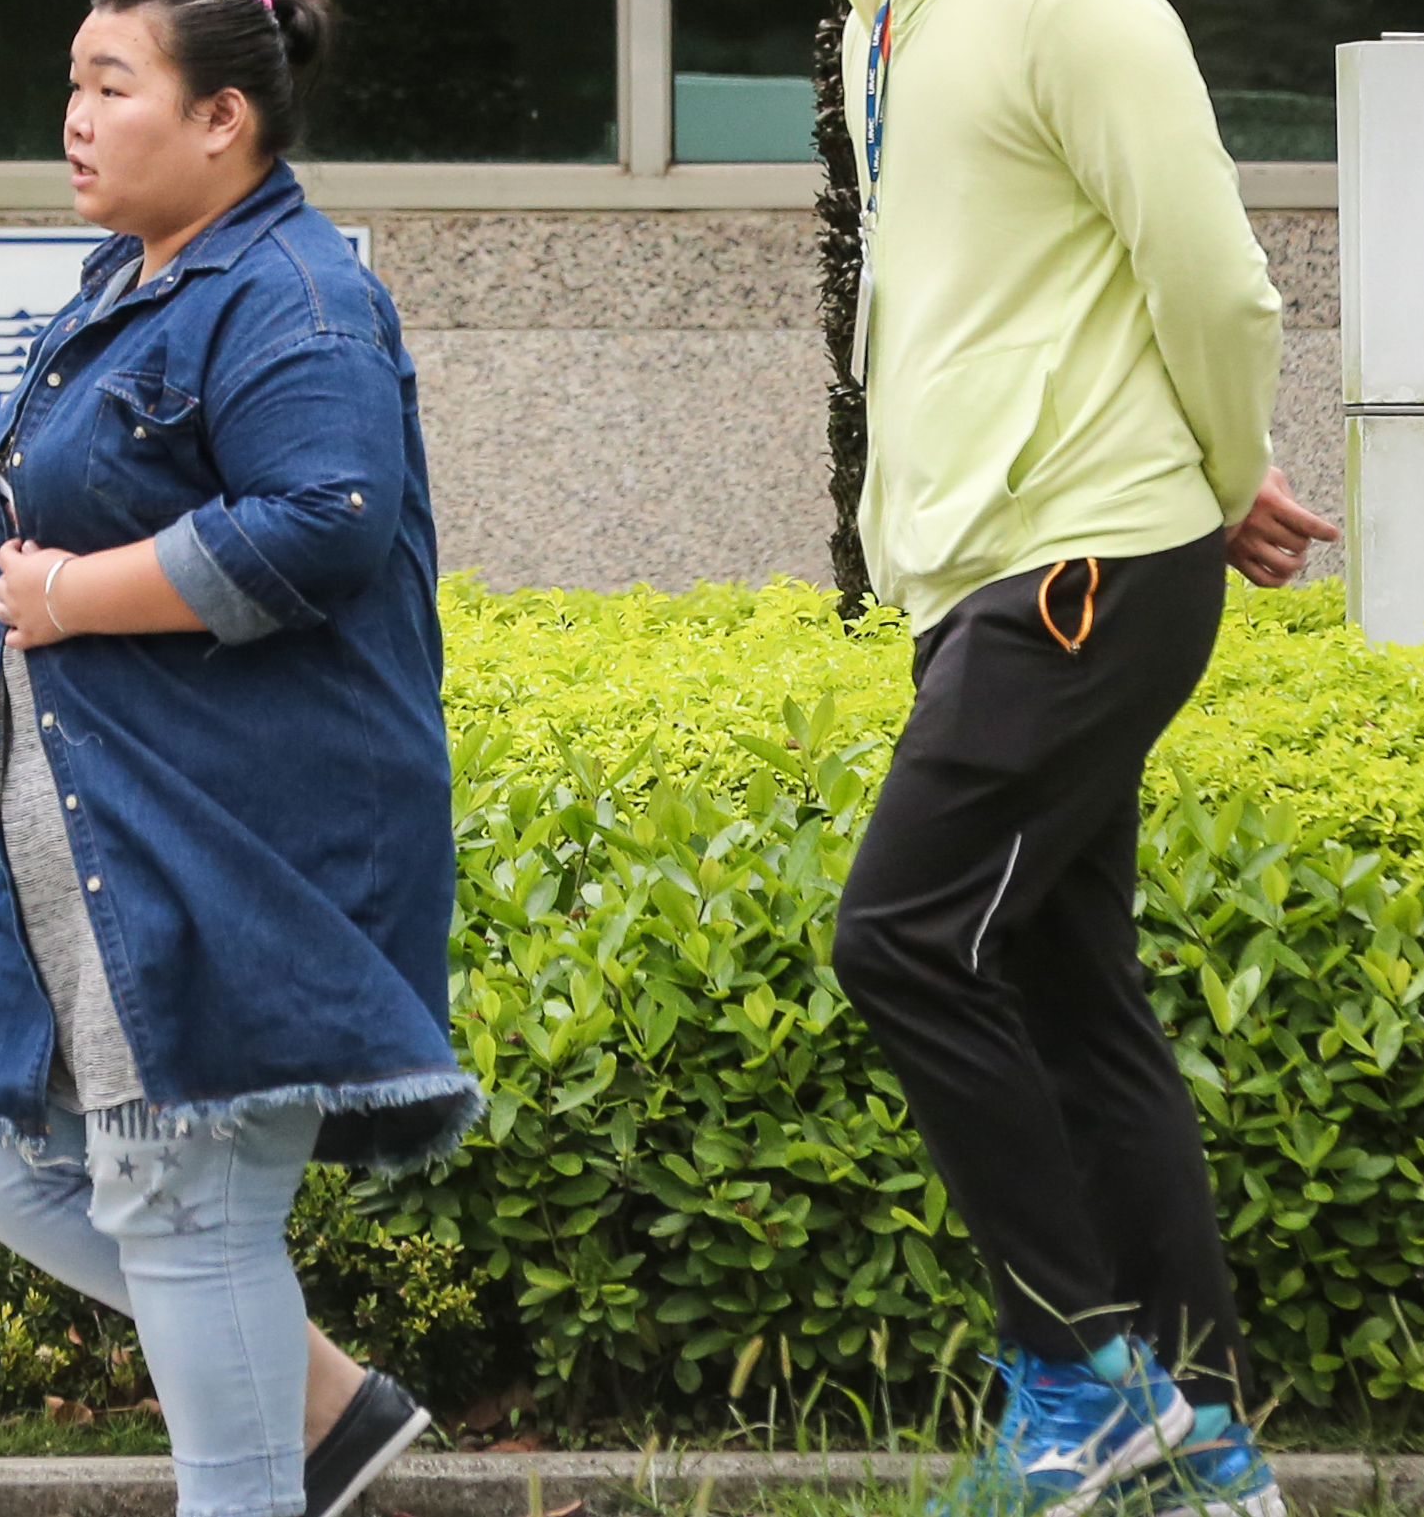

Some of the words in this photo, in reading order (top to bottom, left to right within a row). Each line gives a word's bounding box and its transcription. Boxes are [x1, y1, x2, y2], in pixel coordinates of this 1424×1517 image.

[872, 22, 883, 47] UMC
[868, 68, 876, 95] UMC
[867, 117, 876, 144] UMC
